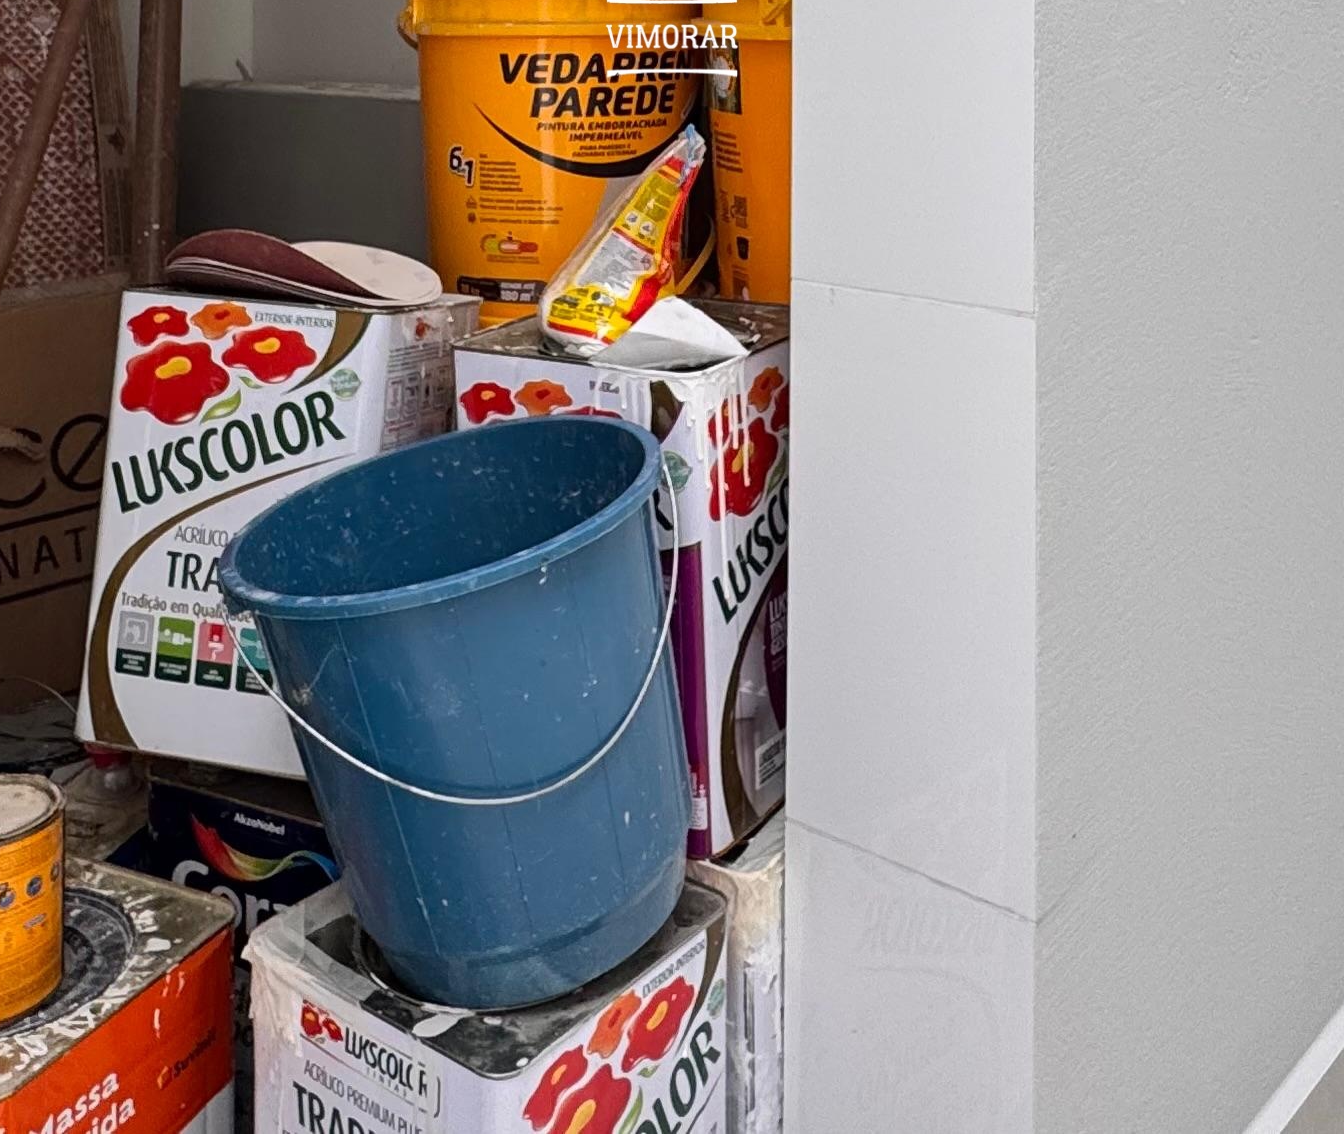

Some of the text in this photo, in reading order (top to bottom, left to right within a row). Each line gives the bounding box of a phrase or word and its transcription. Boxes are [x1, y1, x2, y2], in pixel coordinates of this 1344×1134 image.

[499, 50, 692, 85] VEDAPREN
[529, 83, 677, 118] PAREDE
[536, 118, 668, 131] PINTURA EMBORRACHADA
[568, 130, 644, 142] IMPERMEÁVEL
[111, 391, 346, 514] LUKSCOLOR
[174, 524, 229, 548] ACRÍLICO
[121, 592, 167, 614] Tradição
[170, 602, 189, 615] em
[234, 813, 286, 836] AkzoNobel
[304, 1059, 345, 1098] ACRÍLICO
[347, 1086, 395, 1130] PREMIUM
